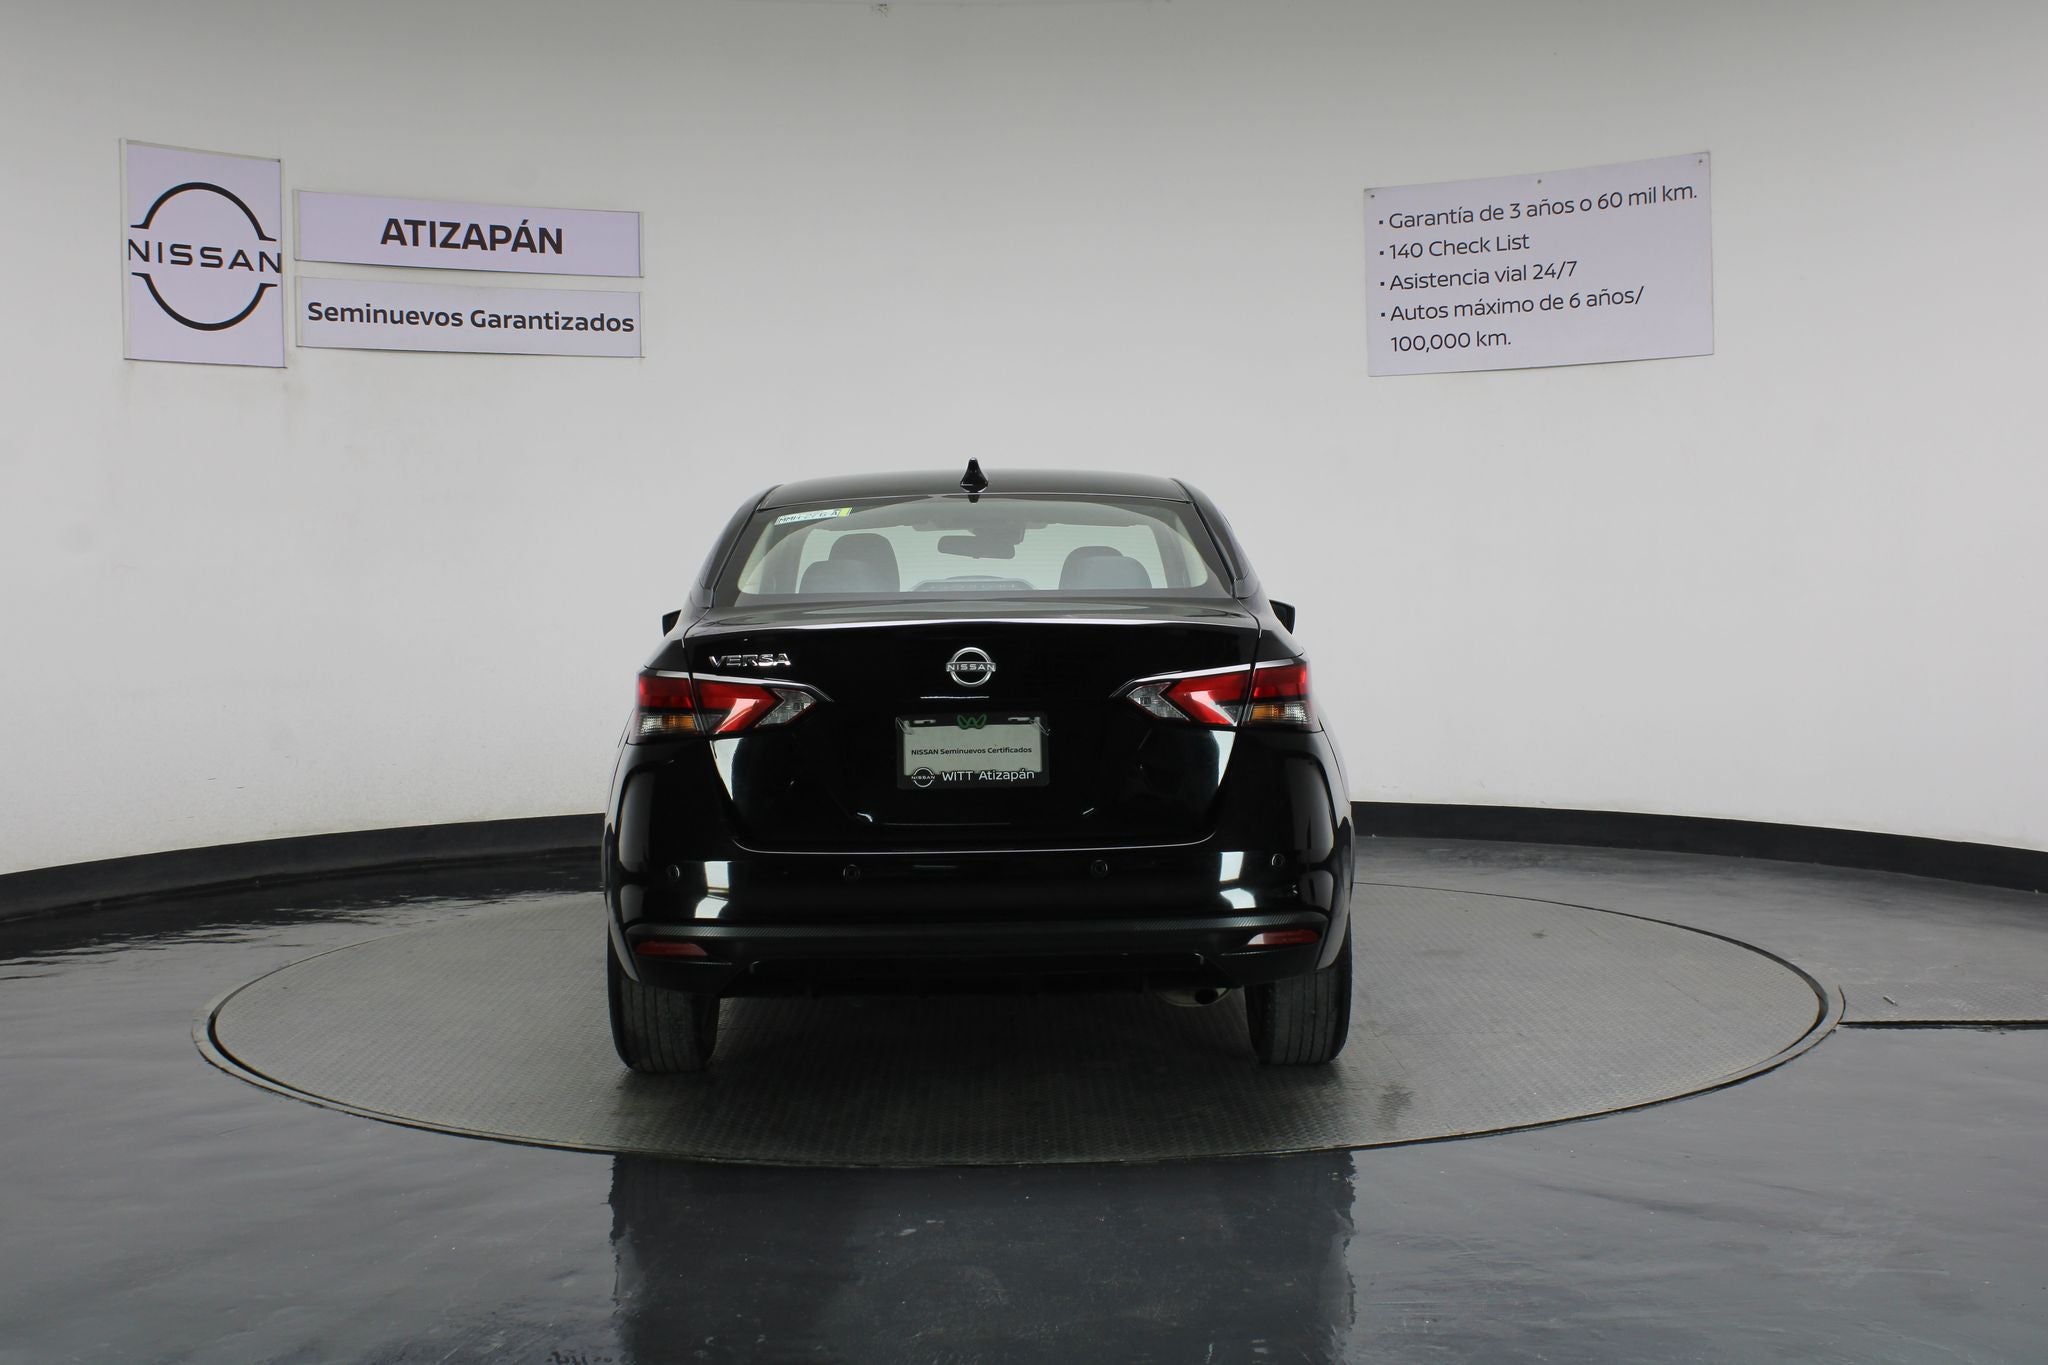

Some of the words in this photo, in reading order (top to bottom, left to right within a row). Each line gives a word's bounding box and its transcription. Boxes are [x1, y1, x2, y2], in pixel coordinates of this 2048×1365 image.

[1388, 206, 1474, 229] Garantía
[1479, 204, 1505, 222] de
[1509, 202, 1521, 220] 3
[1526, 198, 1575, 218] años
[1579, 198, 1593, 212] o
[1597, 191, 1623, 210] 60
[1628, 186, 1657, 207] mil
[1662, 184, 1698, 203] km.
[380, 217, 563, 255] ATIZAPÁN
[1389, 242, 1424, 260] 140
[1428, 236, 1491, 258] Check
[1496, 233, 1531, 252] List
[127, 239, 282, 274] NISSAN
[1389, 268, 1490, 291] Asistencia
[1494, 264, 1528, 284] vial
[1532, 260, 1578, 281] 24/7
[307, 301, 464, 328] Seminuevos
[470, 309, 635, 333] Garantizados
[1390, 304, 1450, 322] Autos
[1453, 297, 1535, 319] máximo
[1539, 293, 1564, 311] de
[1569, 292, 1581, 309] 6
[1586, 285, 1645, 308] años/
[1390, 332, 1471, 353] 100,000
[1476, 330, 1512, 348] km.
[708, 652, 791, 668] VERSA
[947, 663, 995, 672] NISSAN
[940, 748, 986, 756] Seminuevos
[987, 746, 1032, 754] Certificados
[942, 770, 974, 782] WITT
[979, 768, 1035, 783] Atizapán
